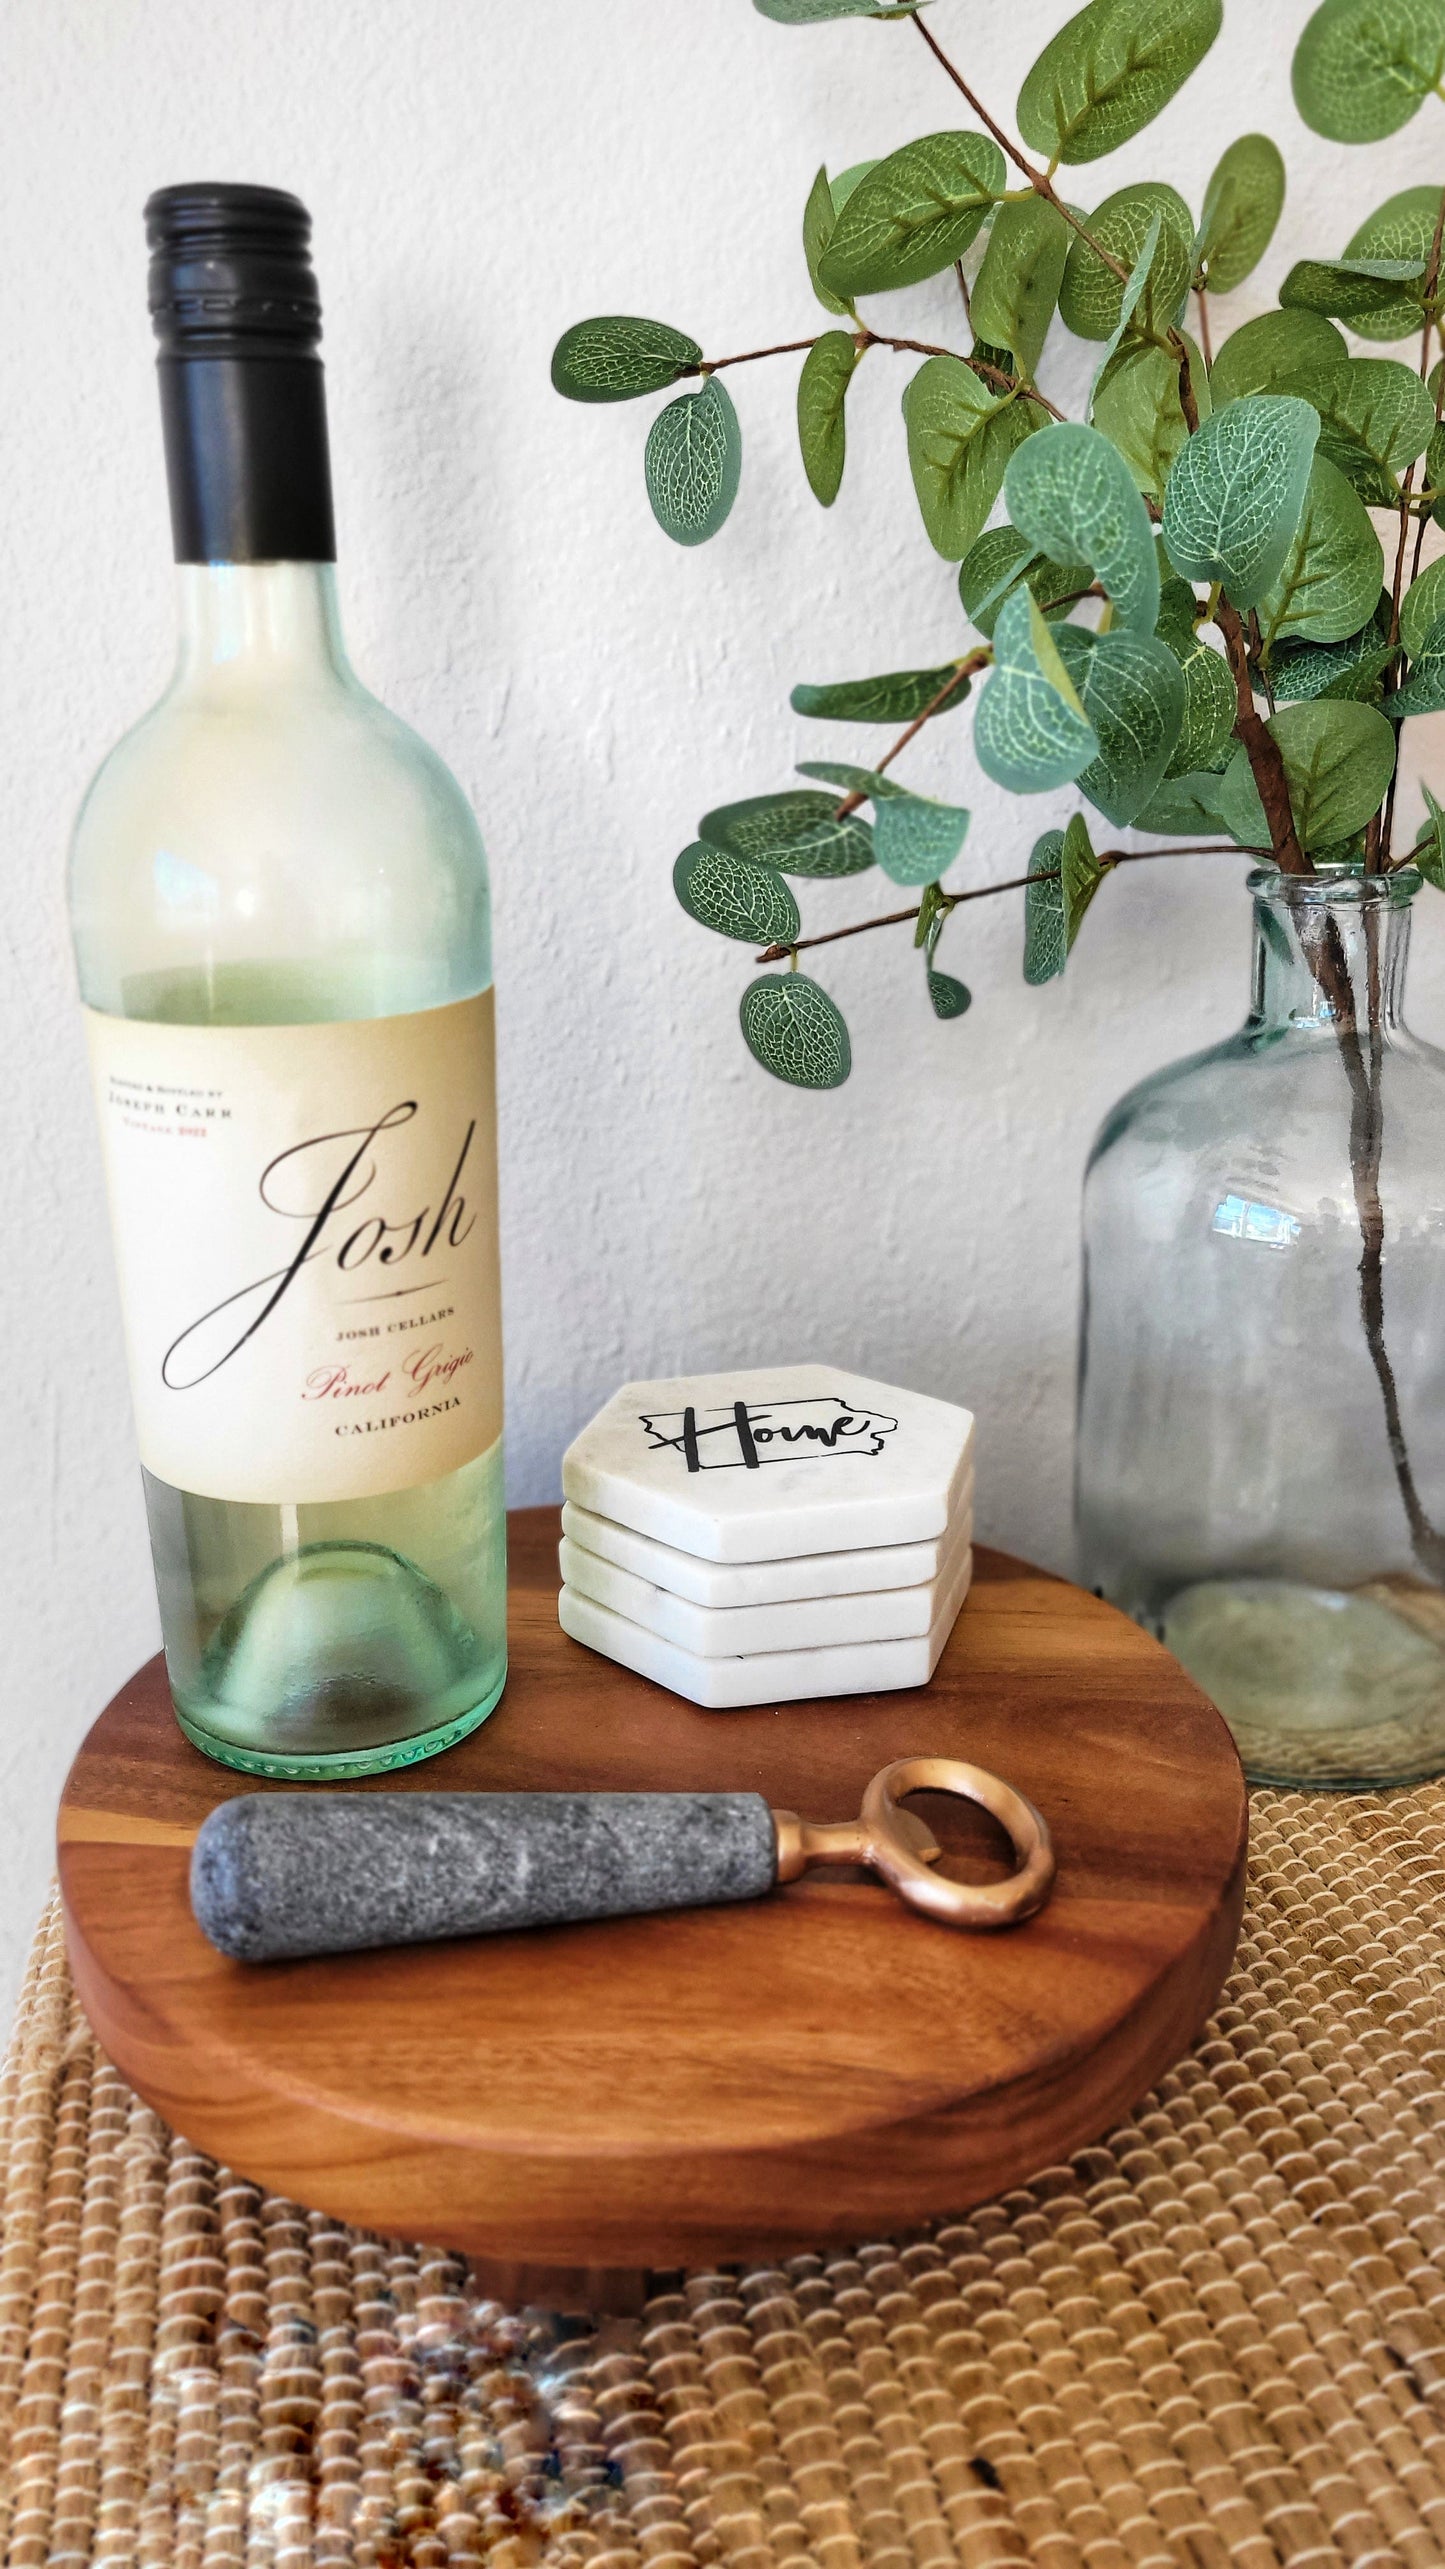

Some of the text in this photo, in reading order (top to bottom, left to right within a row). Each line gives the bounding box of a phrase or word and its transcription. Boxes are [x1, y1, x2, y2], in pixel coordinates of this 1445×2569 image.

[176, 1104, 232, 1118] CARR
[162, 1100, 477, 1390] Josh
[336, 1307, 455, 1341] JOSH CELLARS
[301, 1343, 474, 1400] Pinot Grigio
[335, 1397, 461, 1436] CALIFORNIA
[648, 1401, 871, 1472] Home
